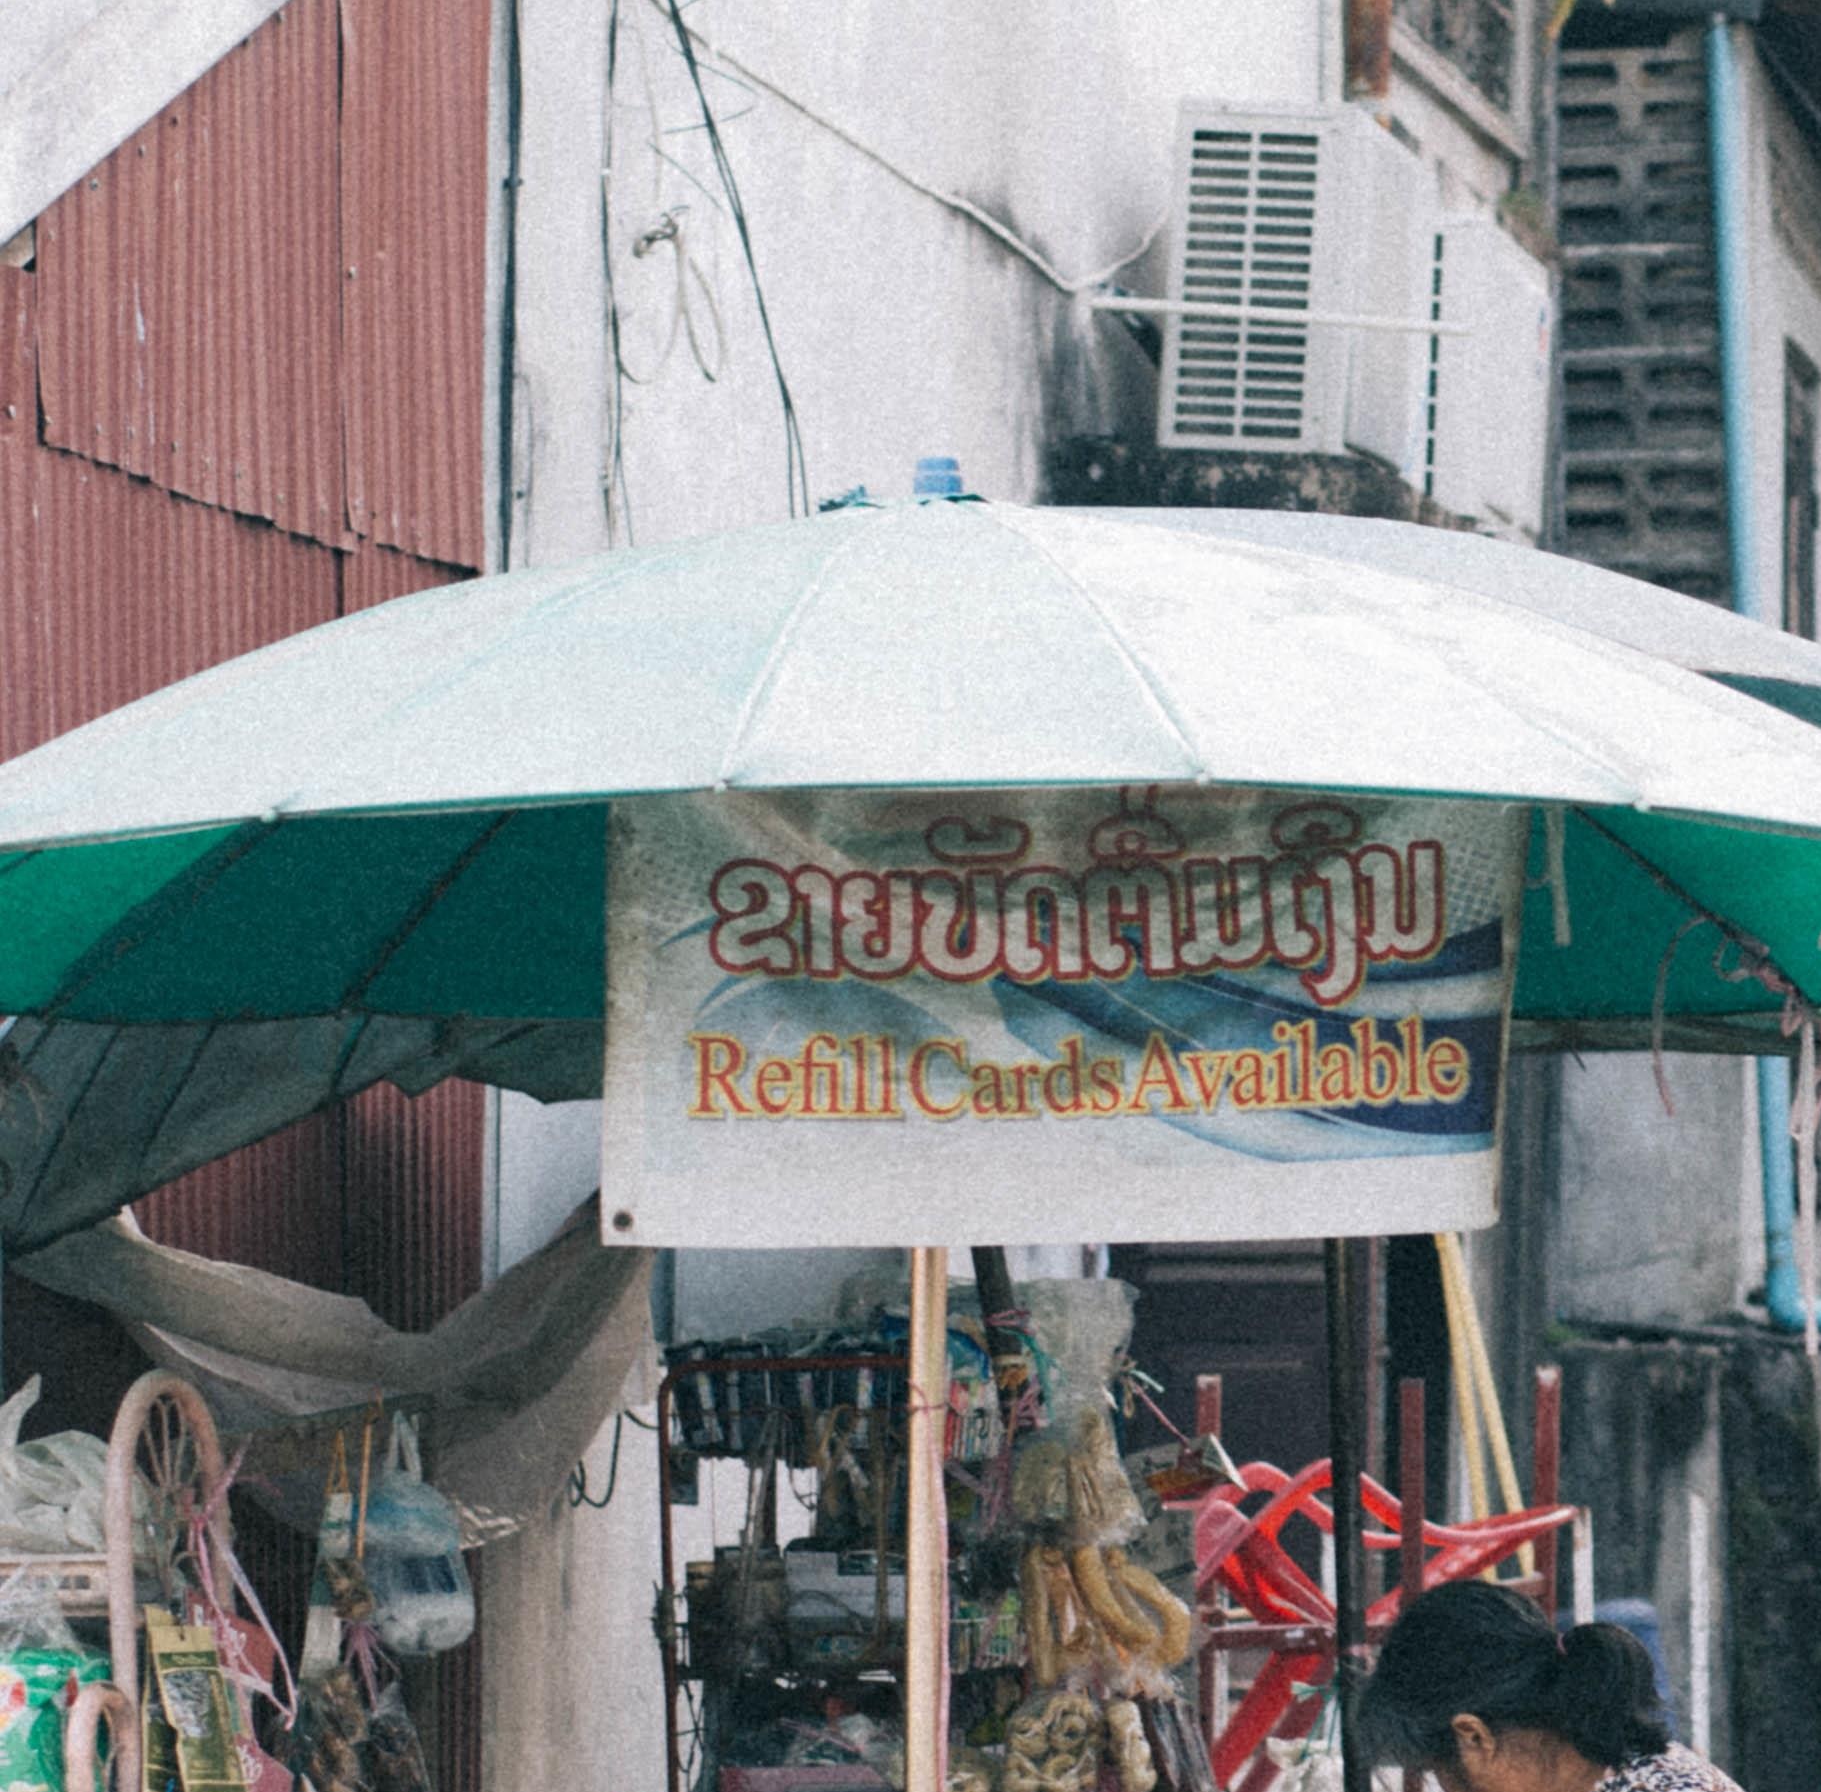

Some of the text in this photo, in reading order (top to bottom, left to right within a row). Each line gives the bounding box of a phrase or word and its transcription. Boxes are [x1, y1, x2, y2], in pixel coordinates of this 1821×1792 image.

[687, 1015, 1468, 1119] Refill Cards Available
